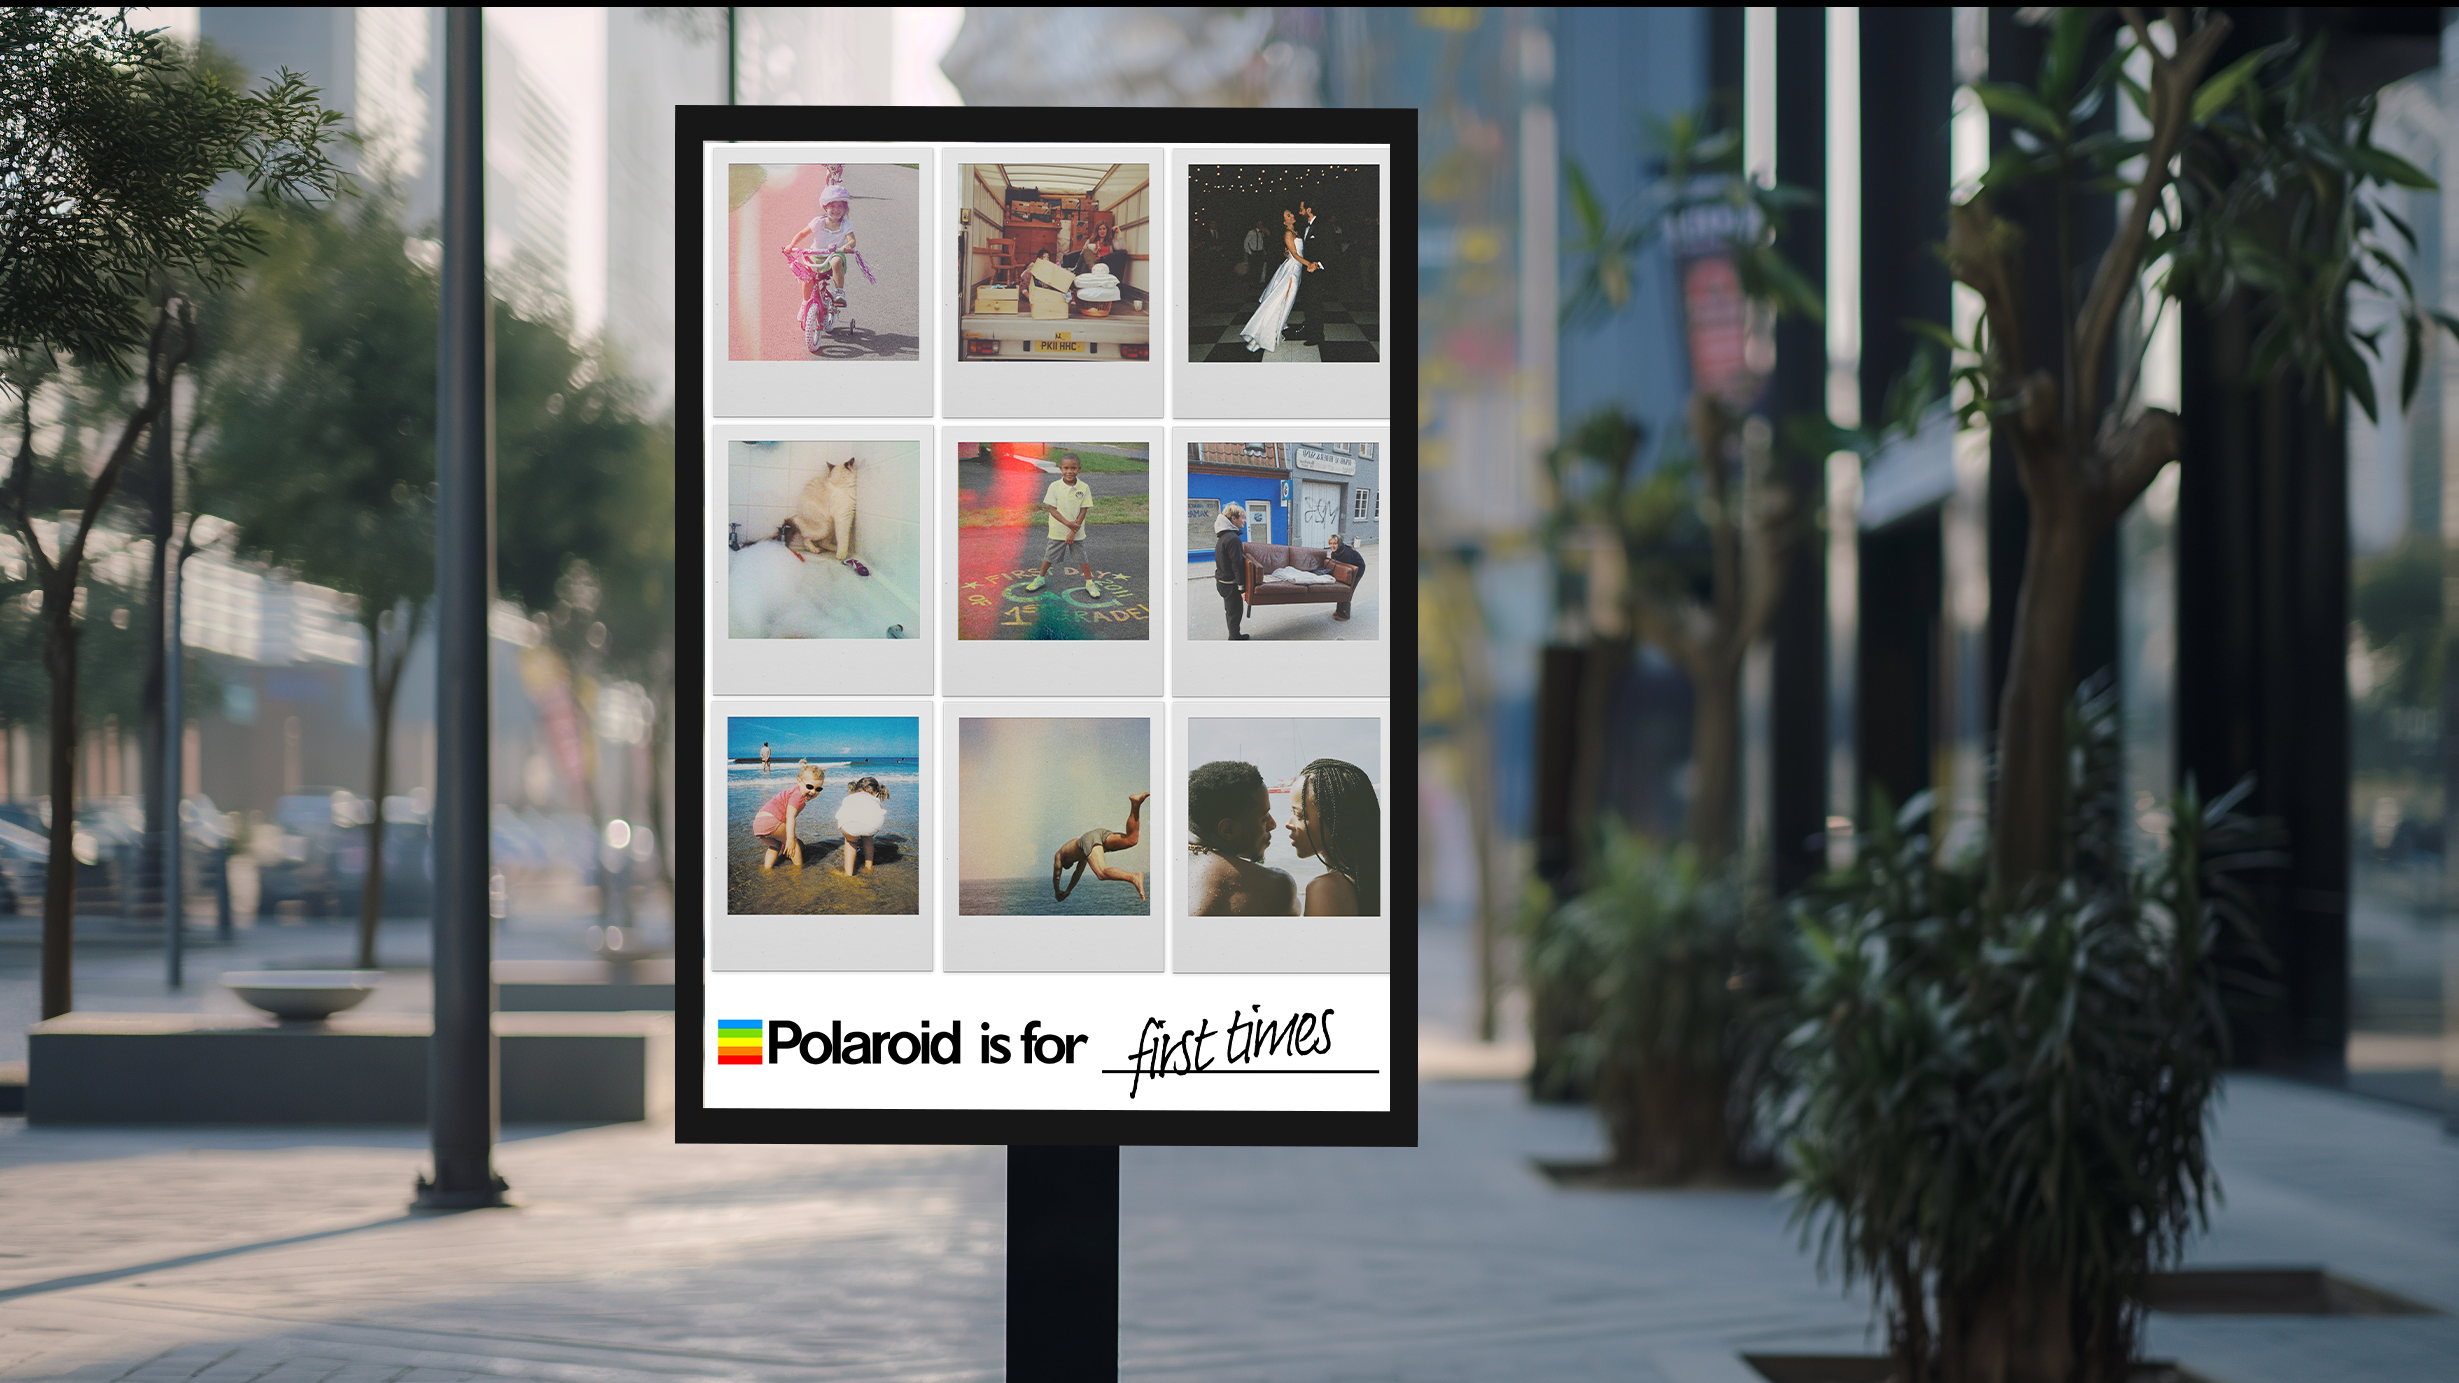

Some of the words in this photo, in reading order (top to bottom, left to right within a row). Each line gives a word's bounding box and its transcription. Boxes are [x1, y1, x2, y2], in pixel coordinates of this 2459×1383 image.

[1059, 341, 1077, 351] HHC
[967, 594, 993, 606] OF
[768, 1020, 962, 1065] Polaroid
[980, 1021, 1012, 1065] is
[1020, 1020, 1089, 1065] for
[1128, 1016, 1219, 1100] first
[1226, 1004, 1335, 1065] times
